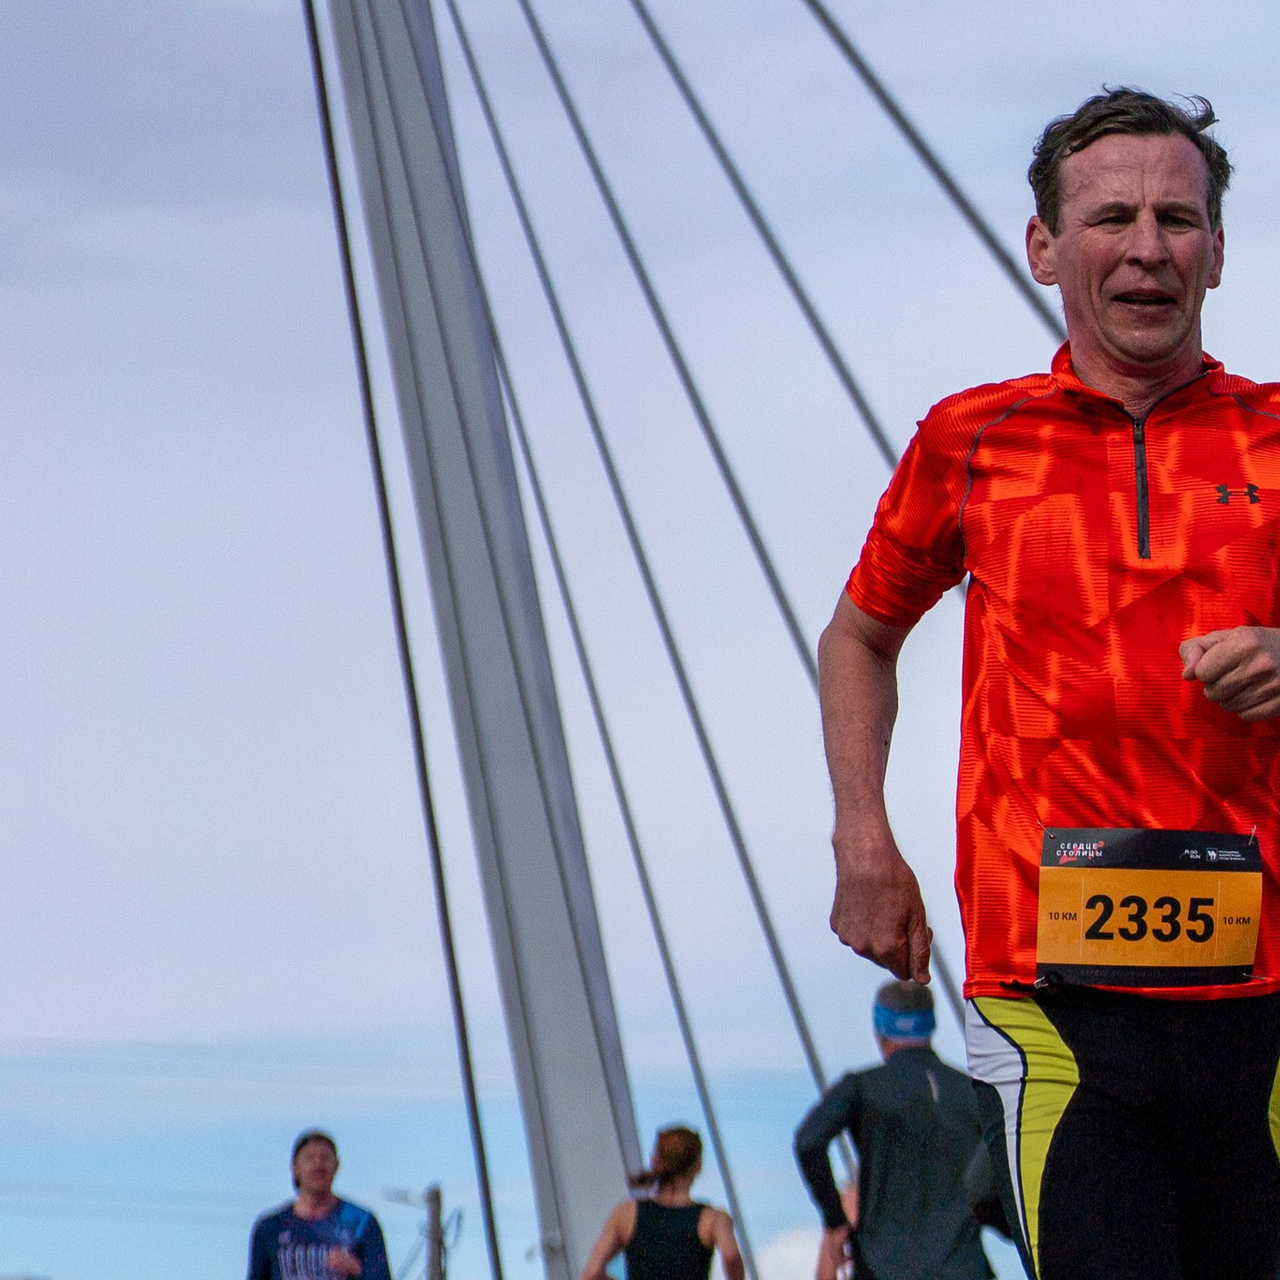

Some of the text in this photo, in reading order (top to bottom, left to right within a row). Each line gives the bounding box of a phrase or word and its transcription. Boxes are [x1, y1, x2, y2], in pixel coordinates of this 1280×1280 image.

[1060, 842, 1098, 850] СЕРДЦЕ
[1048, 911, 1060, 921] 10
[1084, 894, 1215, 943] 2335
[1222, 916, 1234, 926] 10
